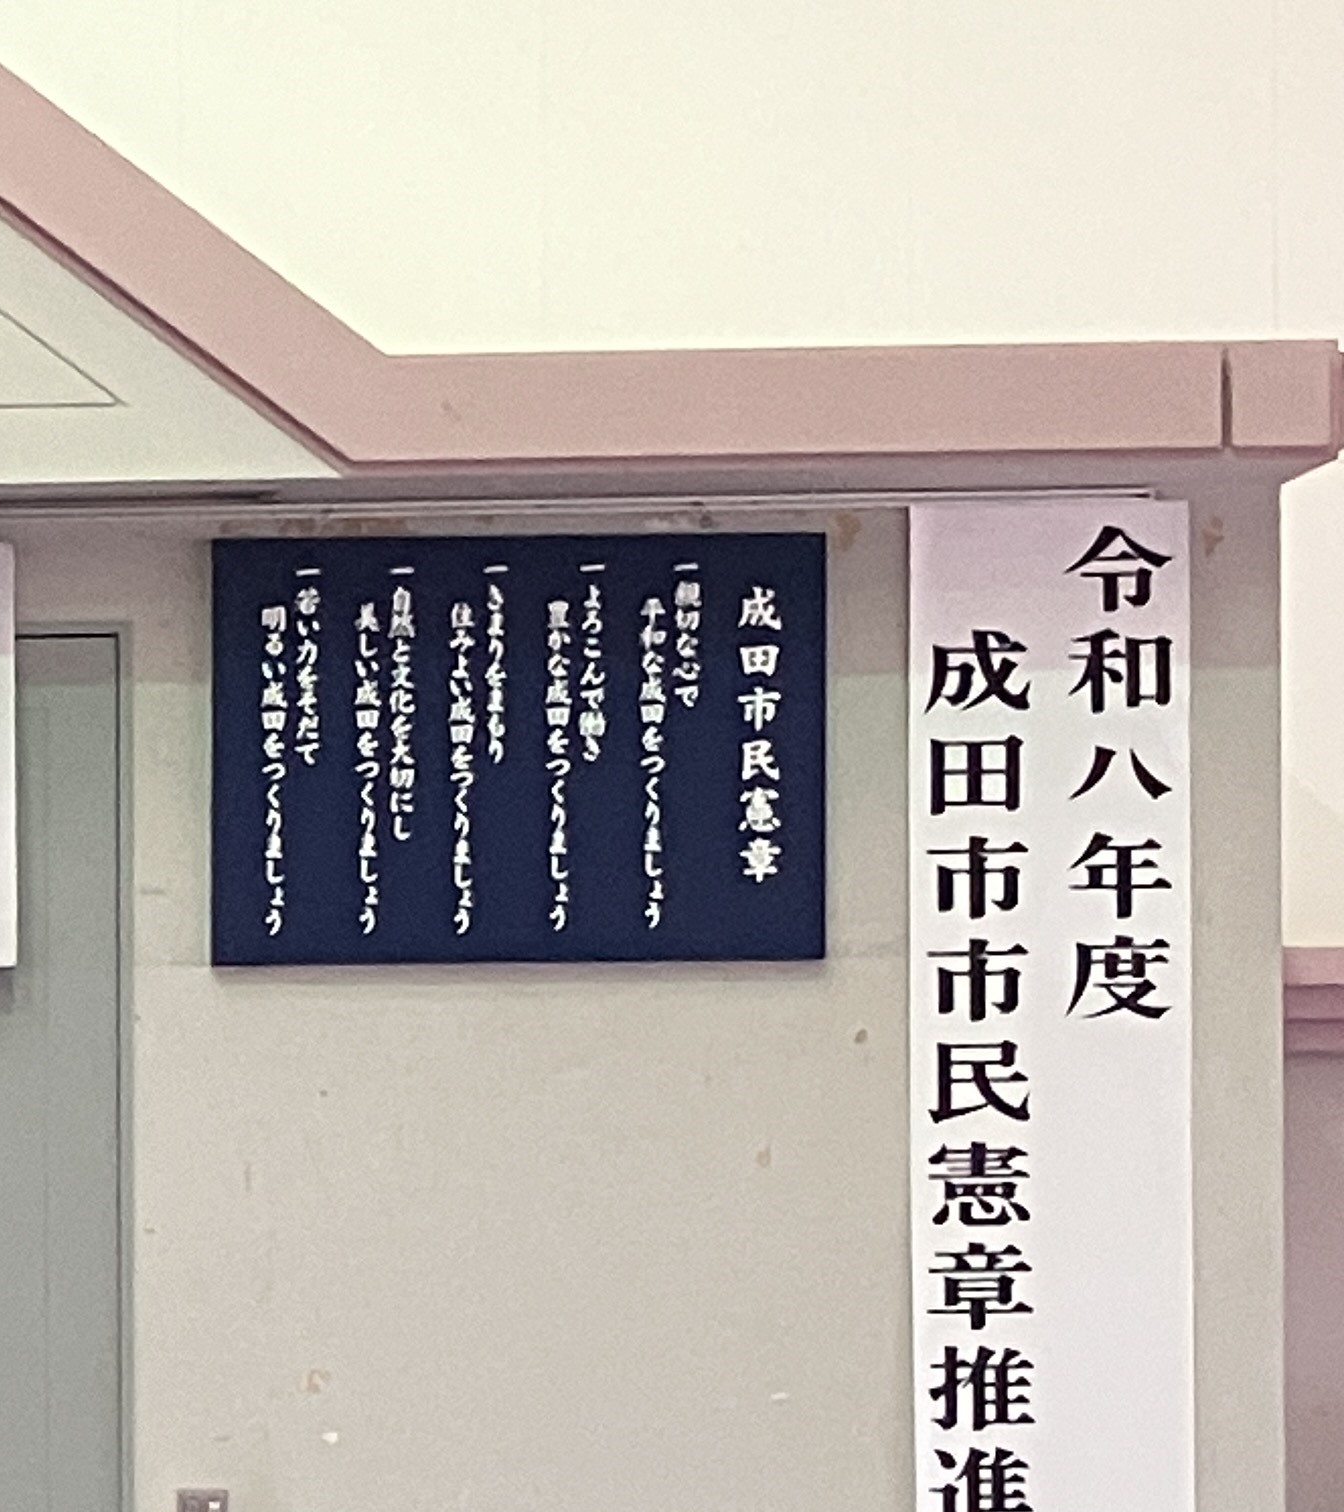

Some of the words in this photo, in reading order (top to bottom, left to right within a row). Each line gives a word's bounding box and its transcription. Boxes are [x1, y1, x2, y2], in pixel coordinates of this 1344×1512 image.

[738, 587, 781, 882] 成田市民憲章
[1065, 526, 1172, 1018] 令和八年度
